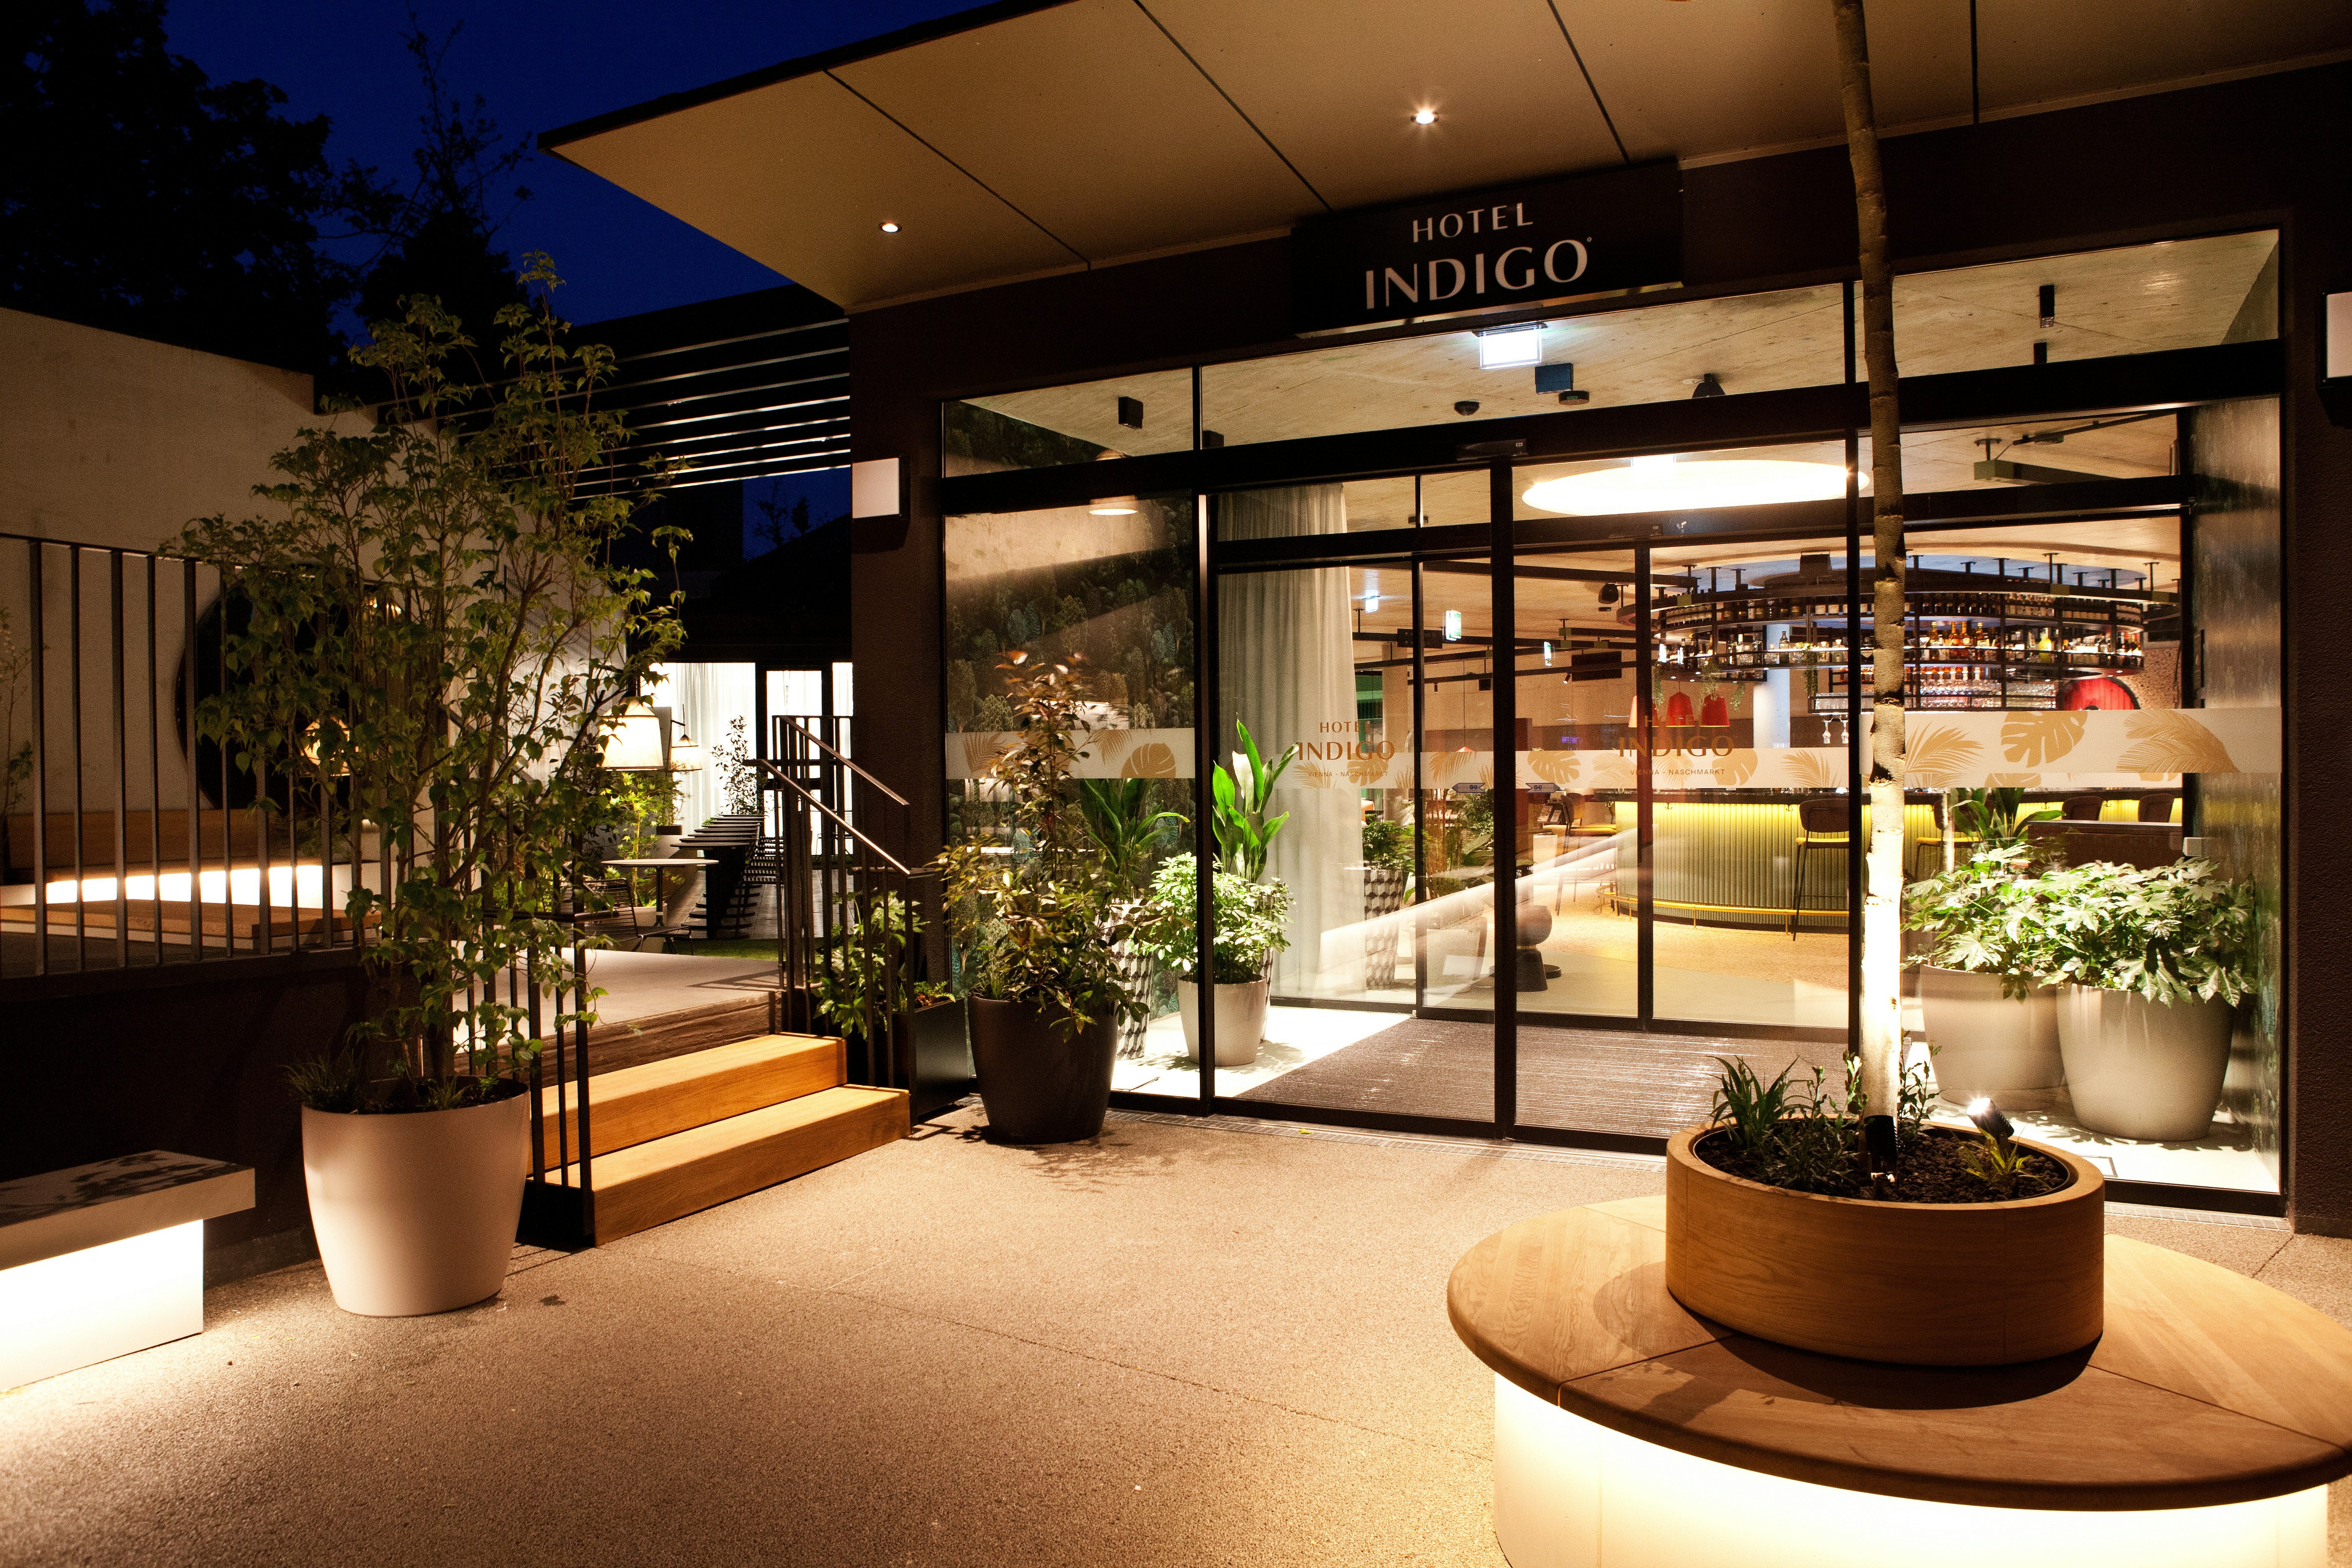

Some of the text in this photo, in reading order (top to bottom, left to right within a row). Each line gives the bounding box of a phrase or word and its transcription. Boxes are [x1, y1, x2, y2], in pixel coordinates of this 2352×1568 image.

[1413, 203, 1533, 243] HOTEL
[1366, 240, 1588, 309] INDIGO
[1320, 721, 1372, 732] HOTEL
[1299, 740, 1395, 761] INDIGO
[1620, 735, 1734, 757] INDIGO
